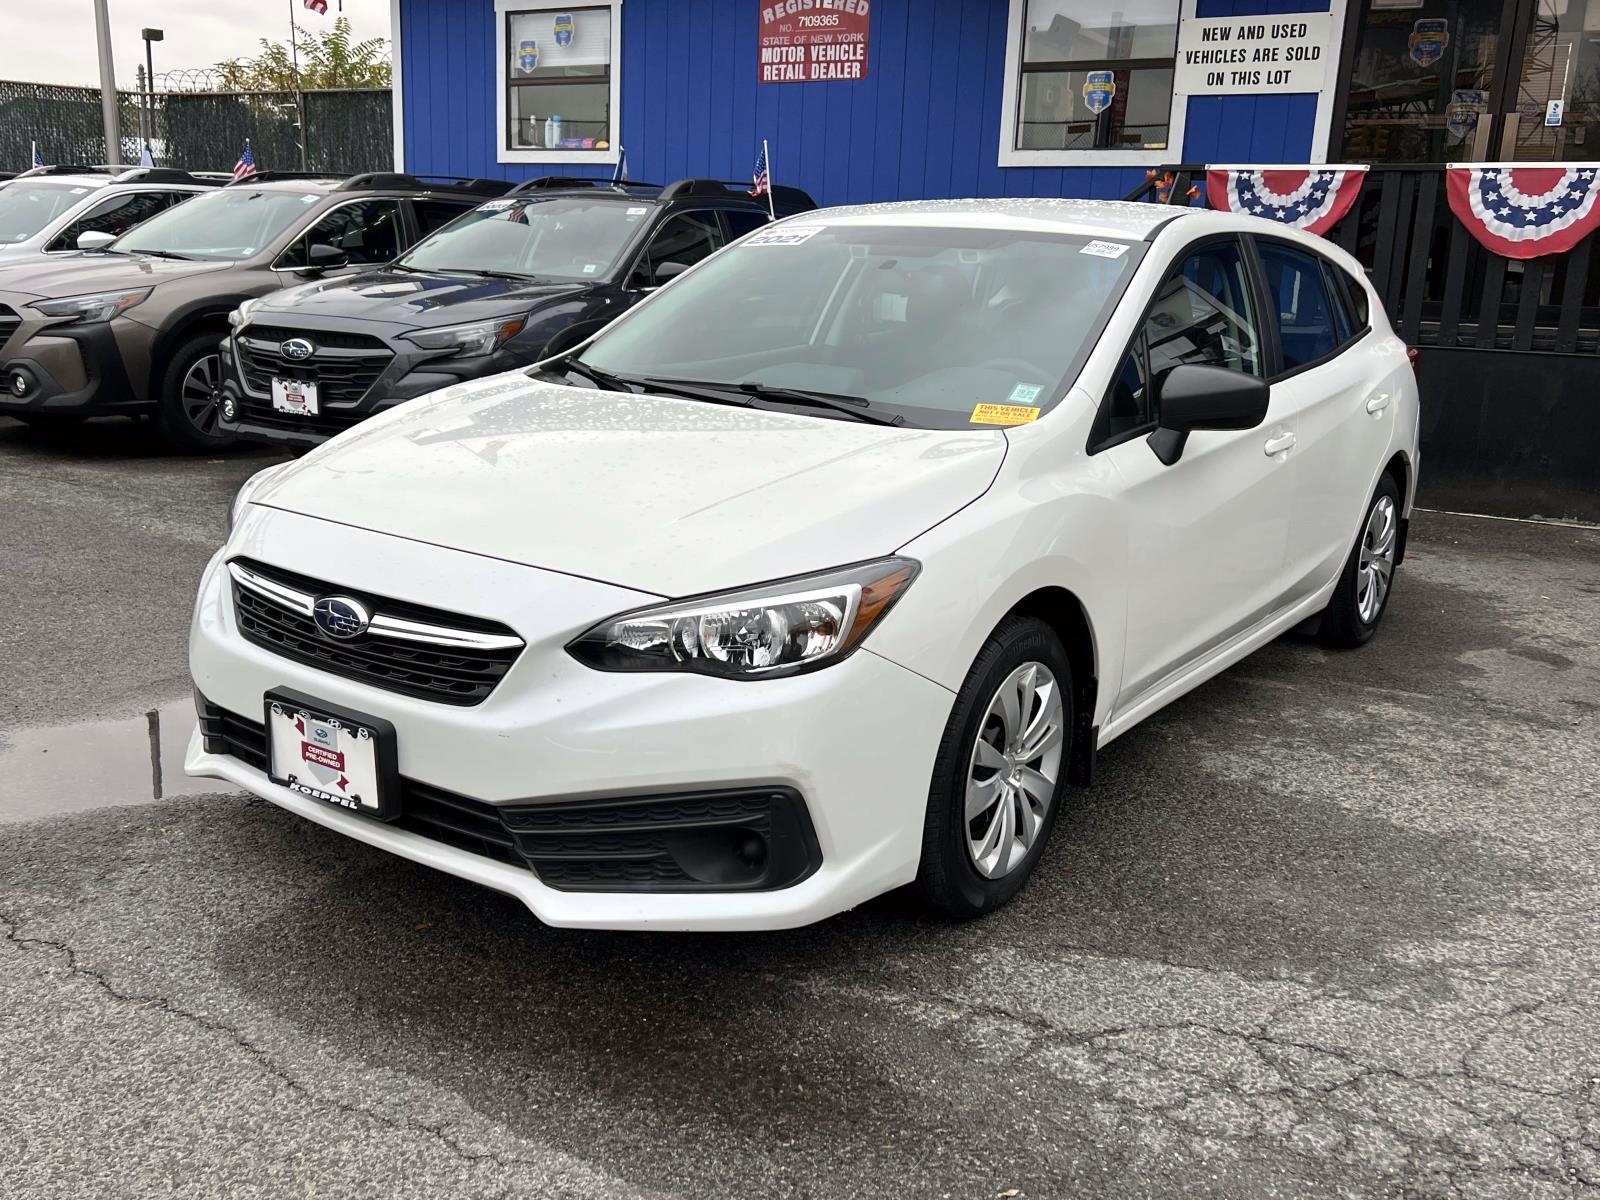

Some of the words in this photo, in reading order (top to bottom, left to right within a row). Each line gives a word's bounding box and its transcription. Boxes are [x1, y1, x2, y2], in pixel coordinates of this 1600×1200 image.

[780, 24, 794, 32] NO.
[798, 14, 839, 27] 7109365
[763, 36, 790, 45] STATE
[794, 35, 807, 44] OF
[811, 34, 833, 43] NEW
[837, 33, 864, 42] YORK
[1202, 26, 1232, 42] NEW
[1237, 25, 1265, 40] AND
[1271, 23, 1307, 39] USED
[762, 46, 805, 63] MOTOR
[811, 44, 864, 61] VEHICLE
[1186, 48, 1247, 64] VEHICLES
[1252, 47, 1280, 62] ARE
[1285, 46, 1321, 61] SOLD
[763, 64, 806, 81] RETAIL
[811, 62, 861, 79] DEALER
[1207, 72, 1225, 86] ON
[1231, 70, 1261, 85] THIS
[1266, 70, 1292, 85] LOT
[1001, 406, 1036, 414] VEHICLE
[305, 752, 340, 768] PRE-OWNED
[307, 746, 337, 760] CERTIFIED
[289, 782, 358, 810] KOEPPEL
